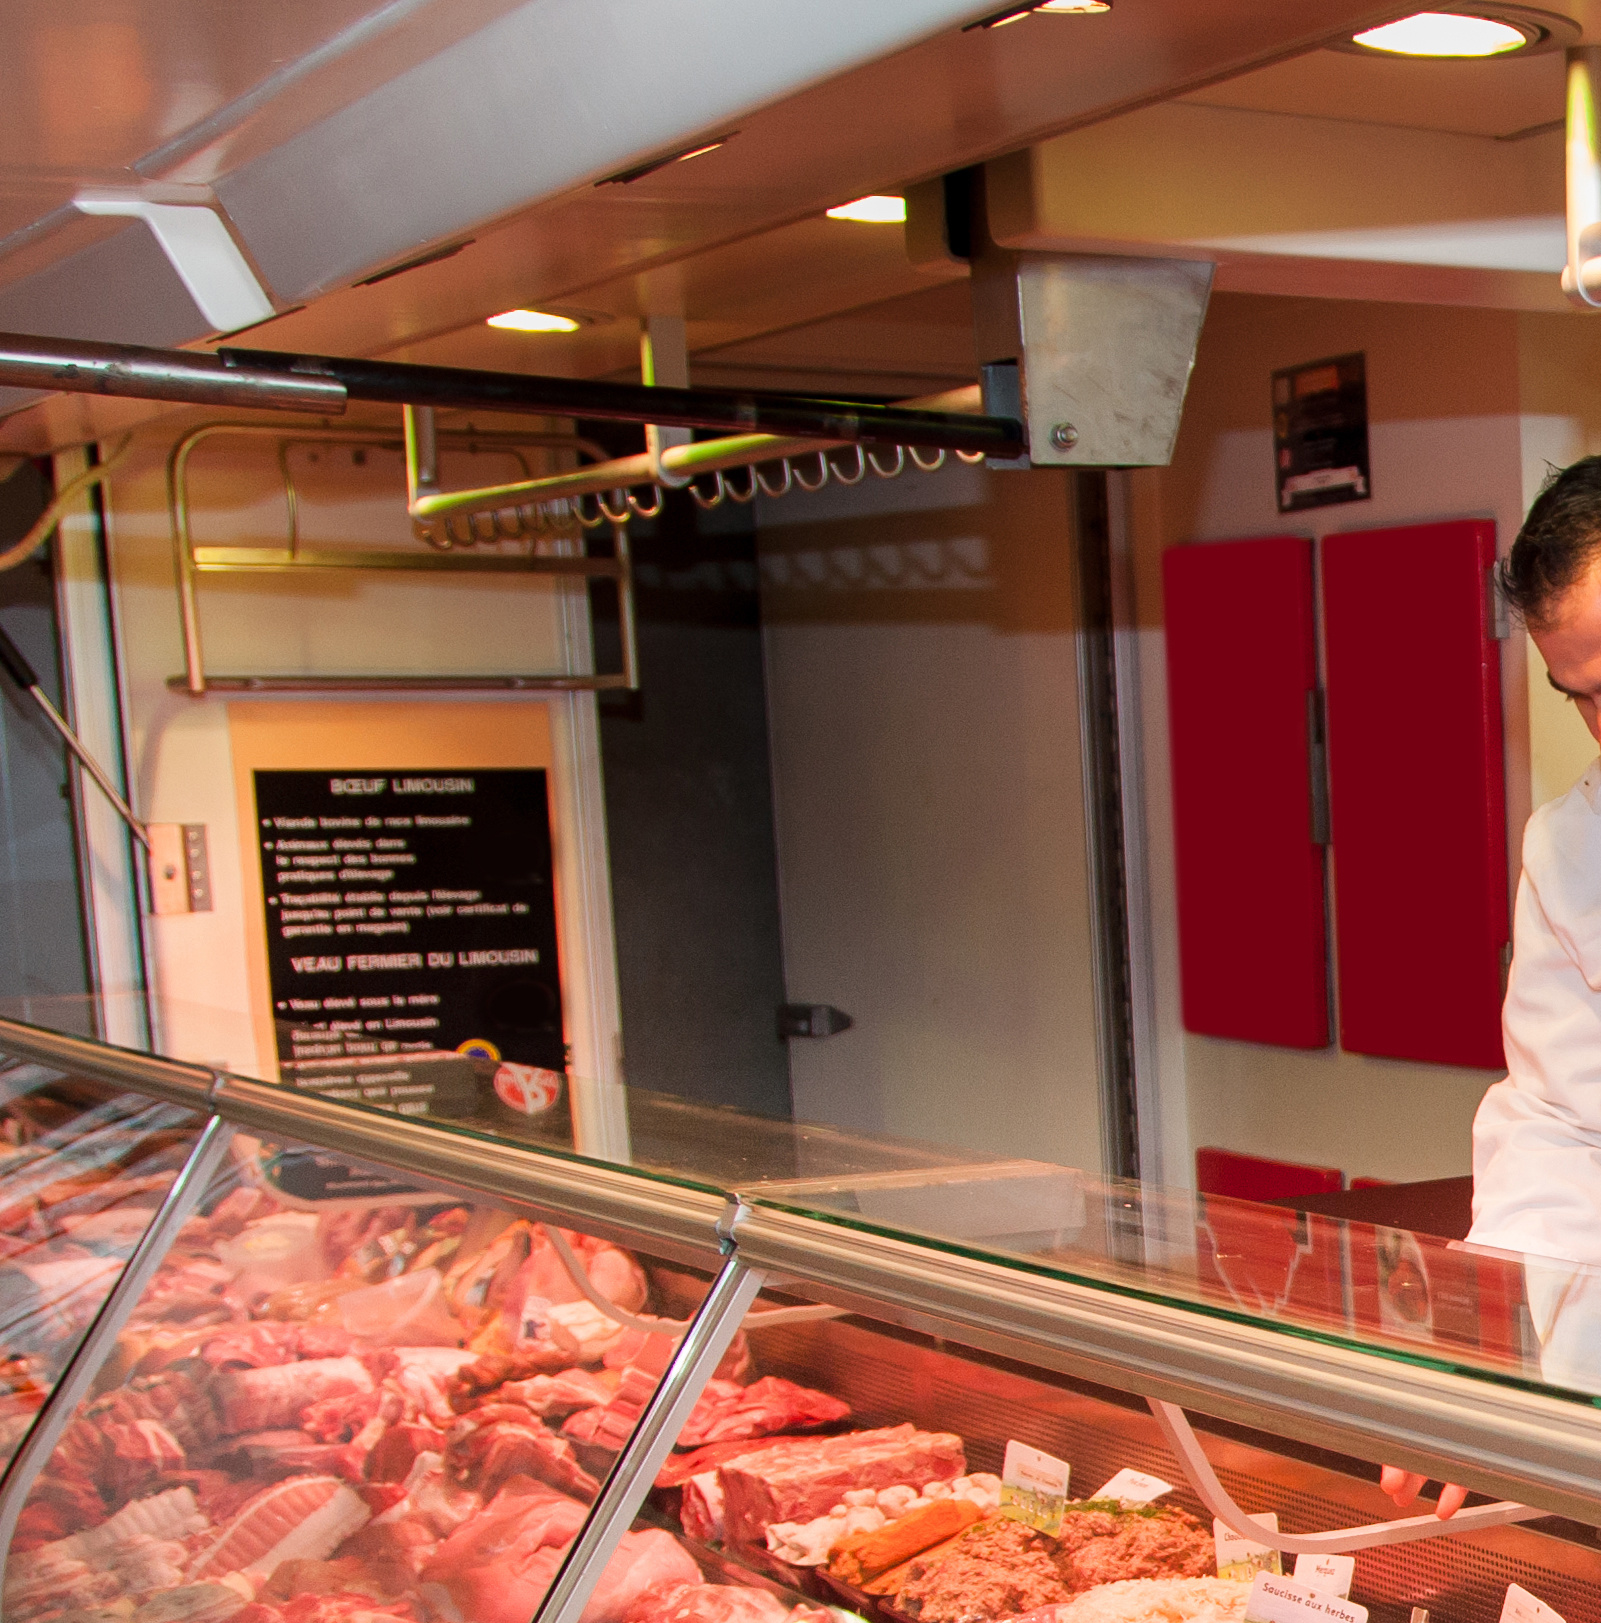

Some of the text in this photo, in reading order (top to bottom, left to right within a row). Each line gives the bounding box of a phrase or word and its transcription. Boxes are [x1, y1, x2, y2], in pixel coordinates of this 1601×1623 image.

[392, 777, 475, 794] LIMOUSIN
[291, 949, 540, 973] VEAU FERMIER DU LIMOUSIN
[1262, 1582, 1355, 1623] Saucisse aux herbes
